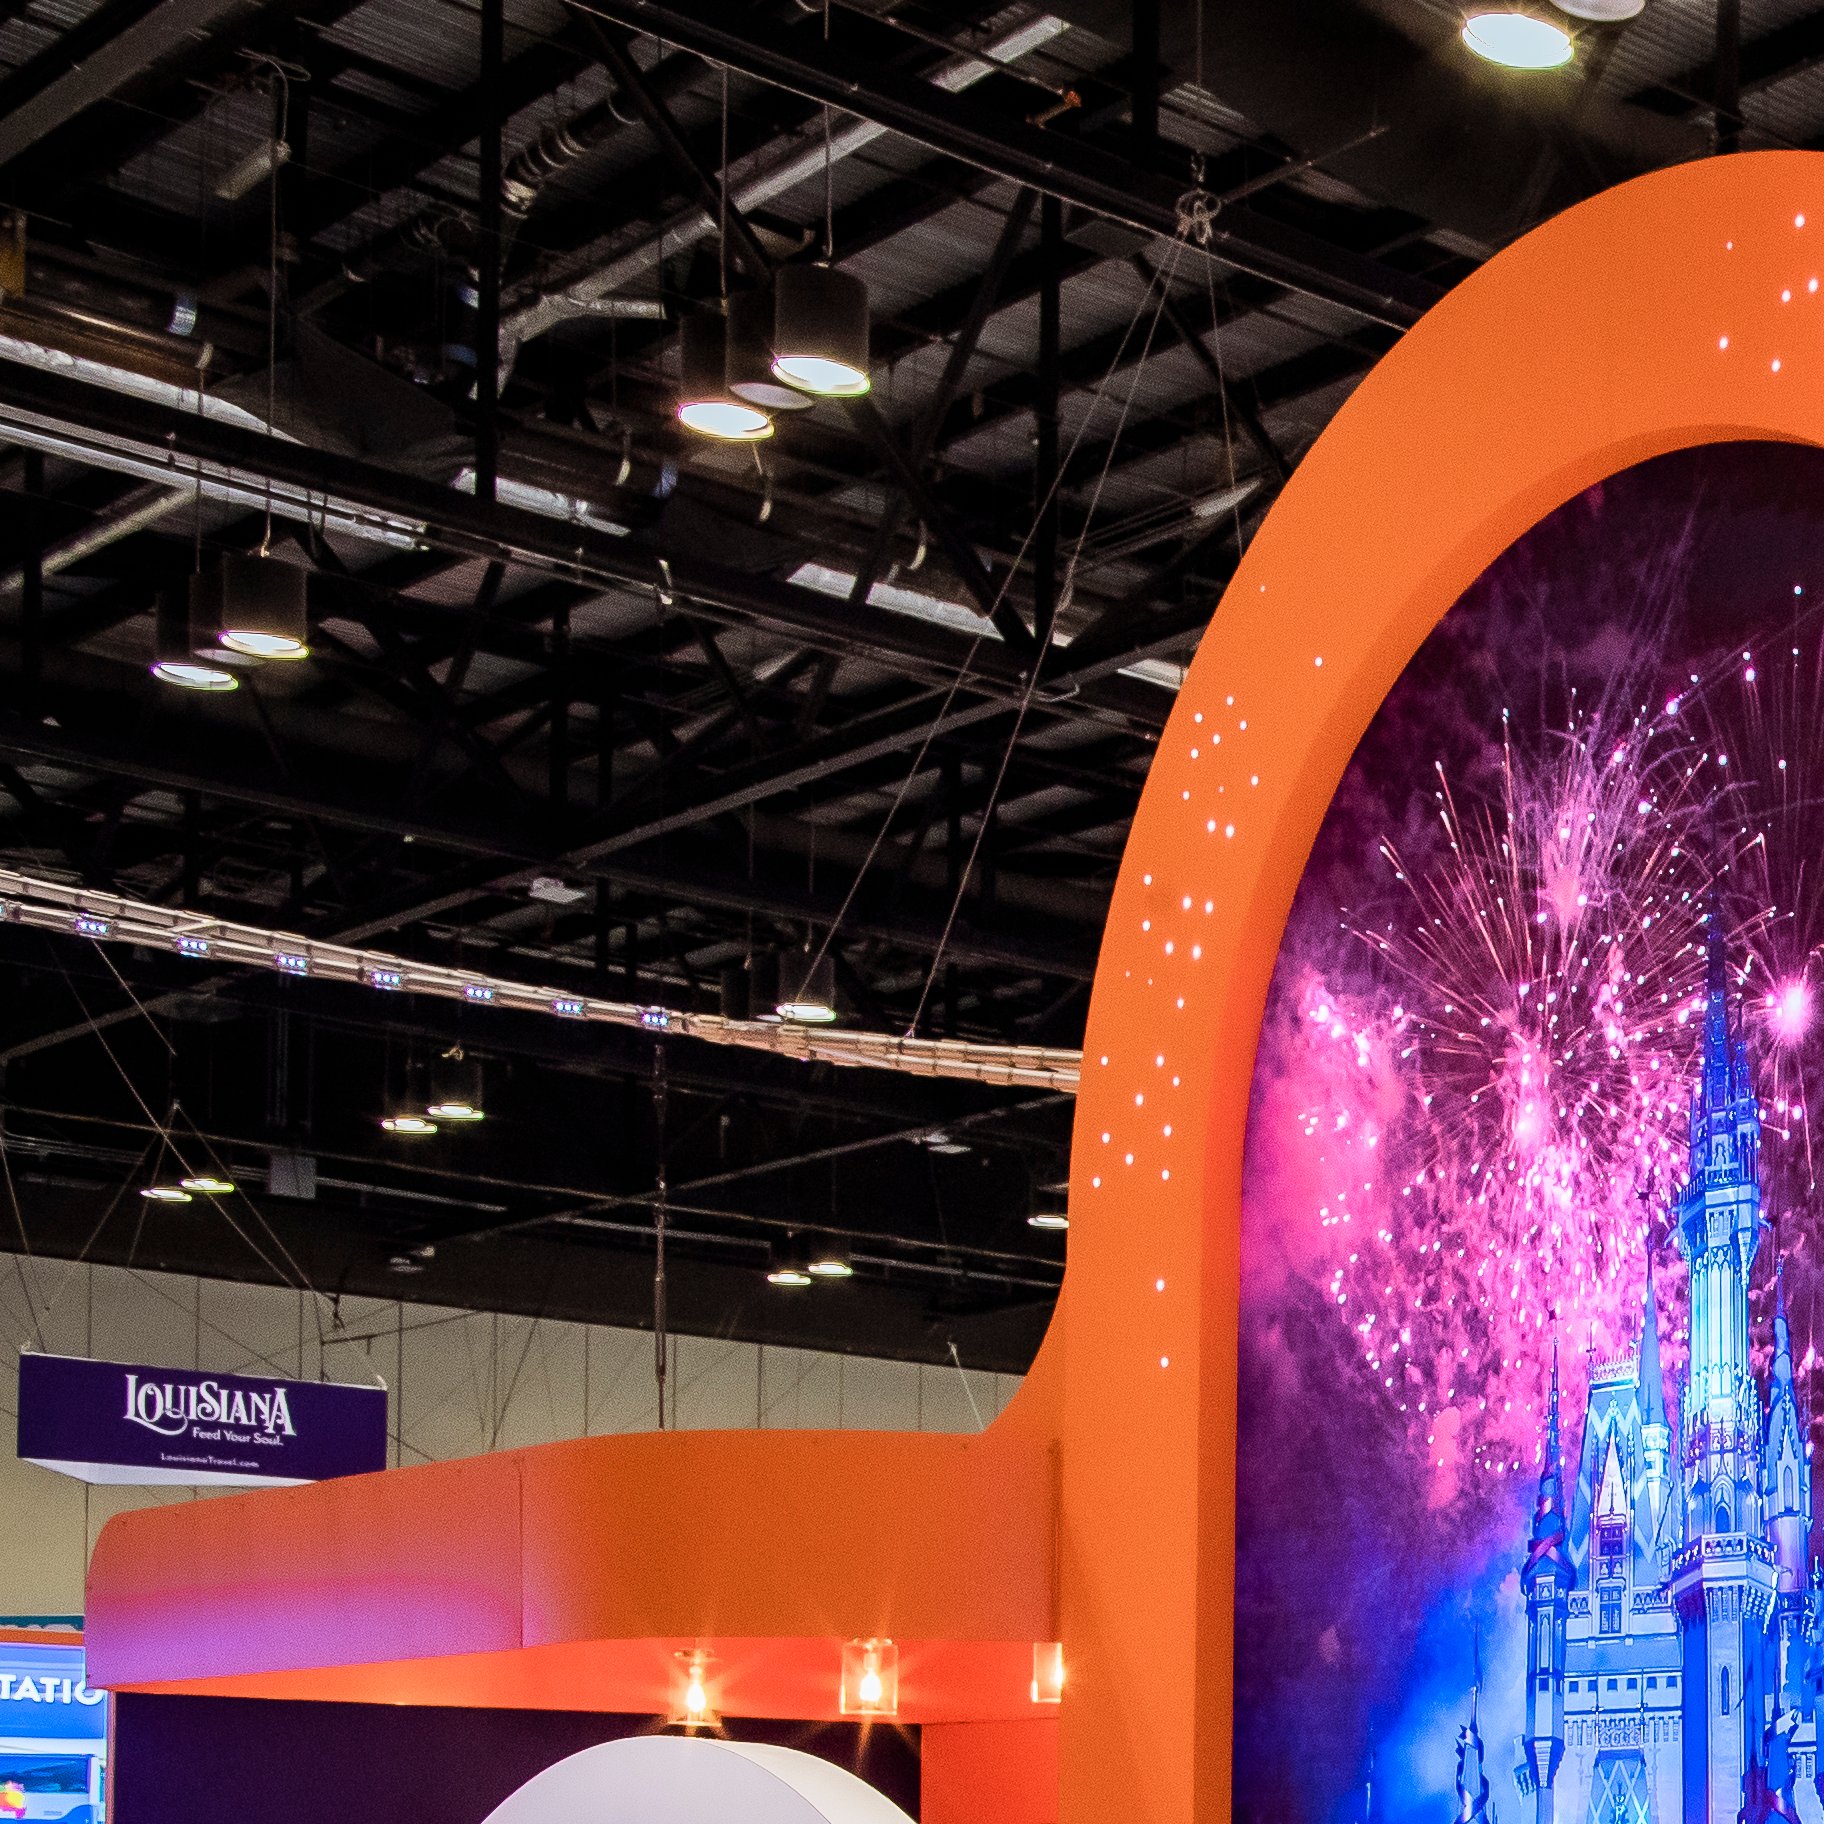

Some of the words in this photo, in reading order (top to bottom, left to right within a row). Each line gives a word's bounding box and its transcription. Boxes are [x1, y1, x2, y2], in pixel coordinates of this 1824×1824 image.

[122, 1373, 298, 1437] LOUISIANA
[192, 1427, 221, 1441] Feed
[224, 1430, 252, 1444] Your
